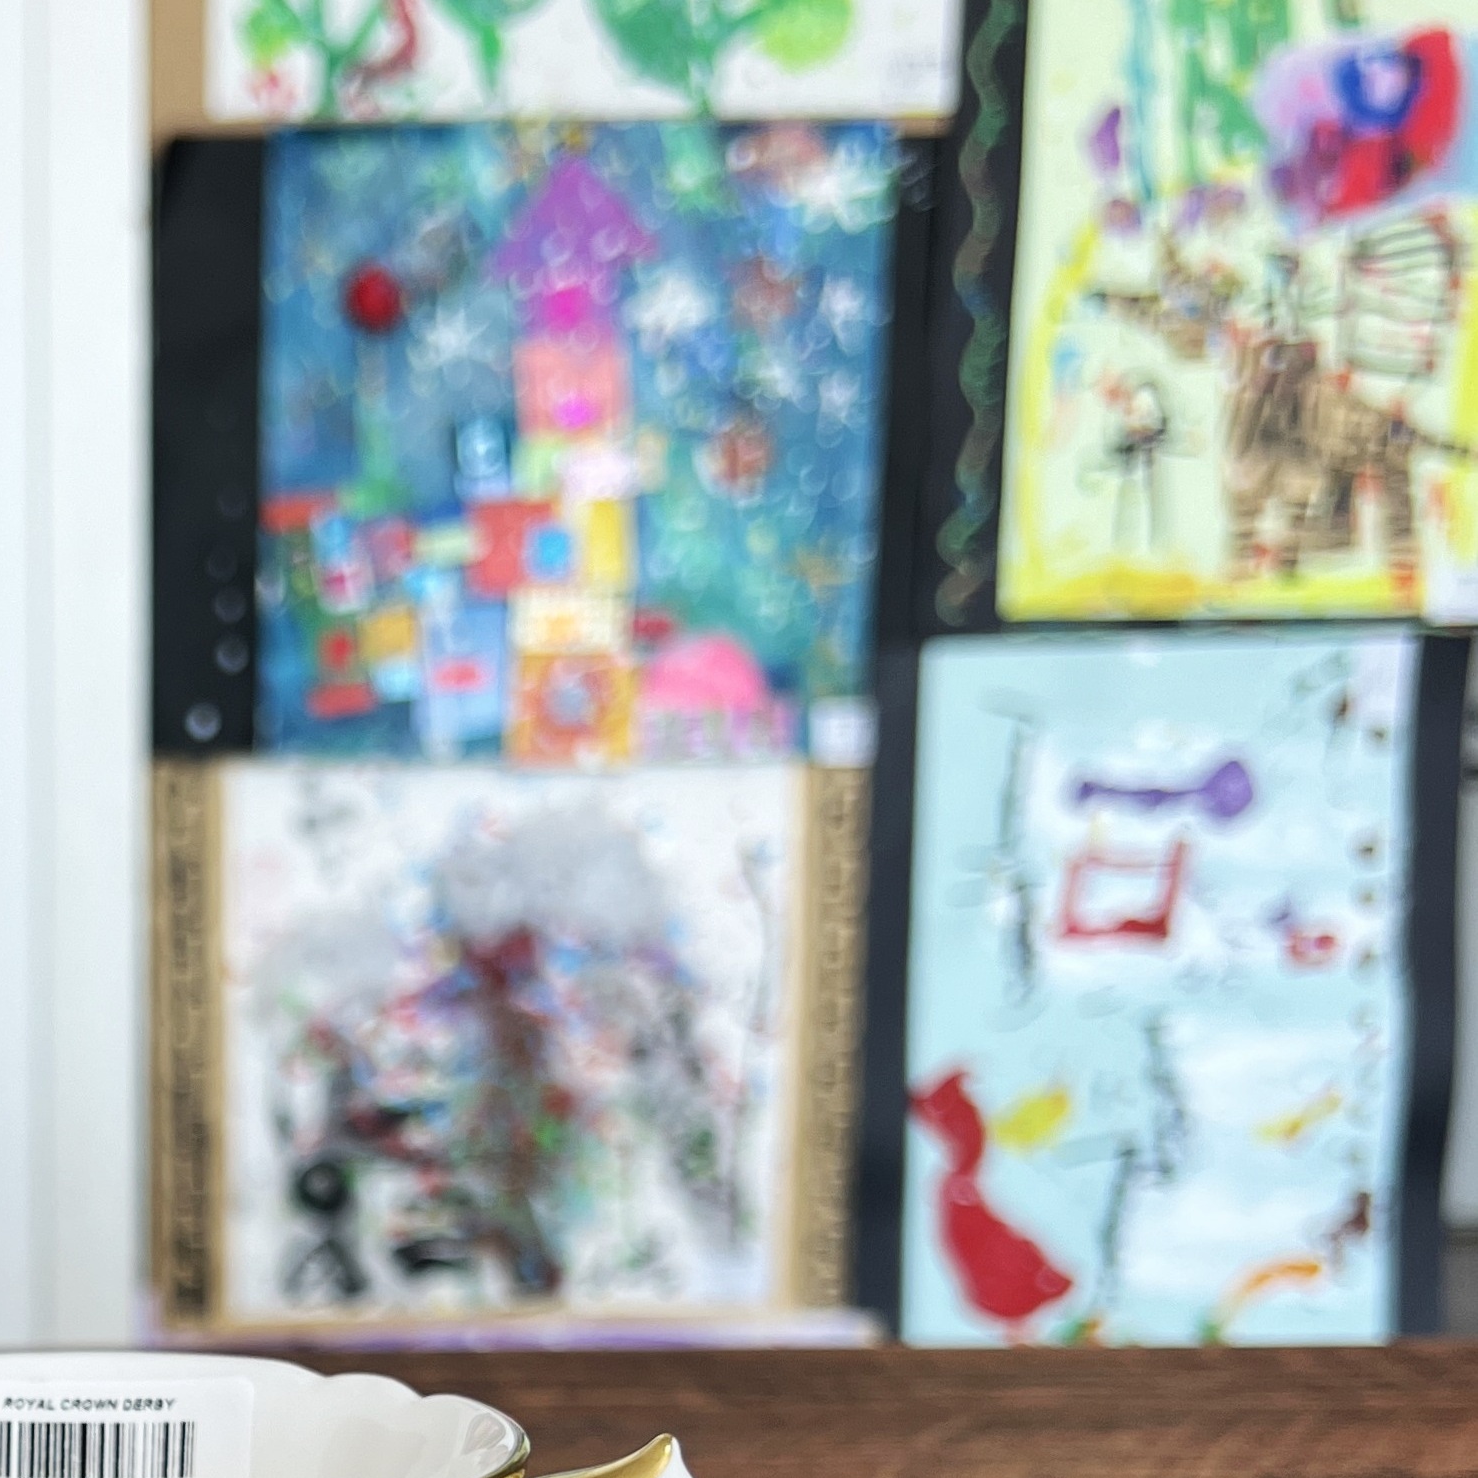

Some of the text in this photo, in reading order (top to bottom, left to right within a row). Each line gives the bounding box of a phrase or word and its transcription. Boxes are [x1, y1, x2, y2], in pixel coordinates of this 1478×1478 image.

[3, 1397, 177, 1411] ROYAL CROWN DERBY
